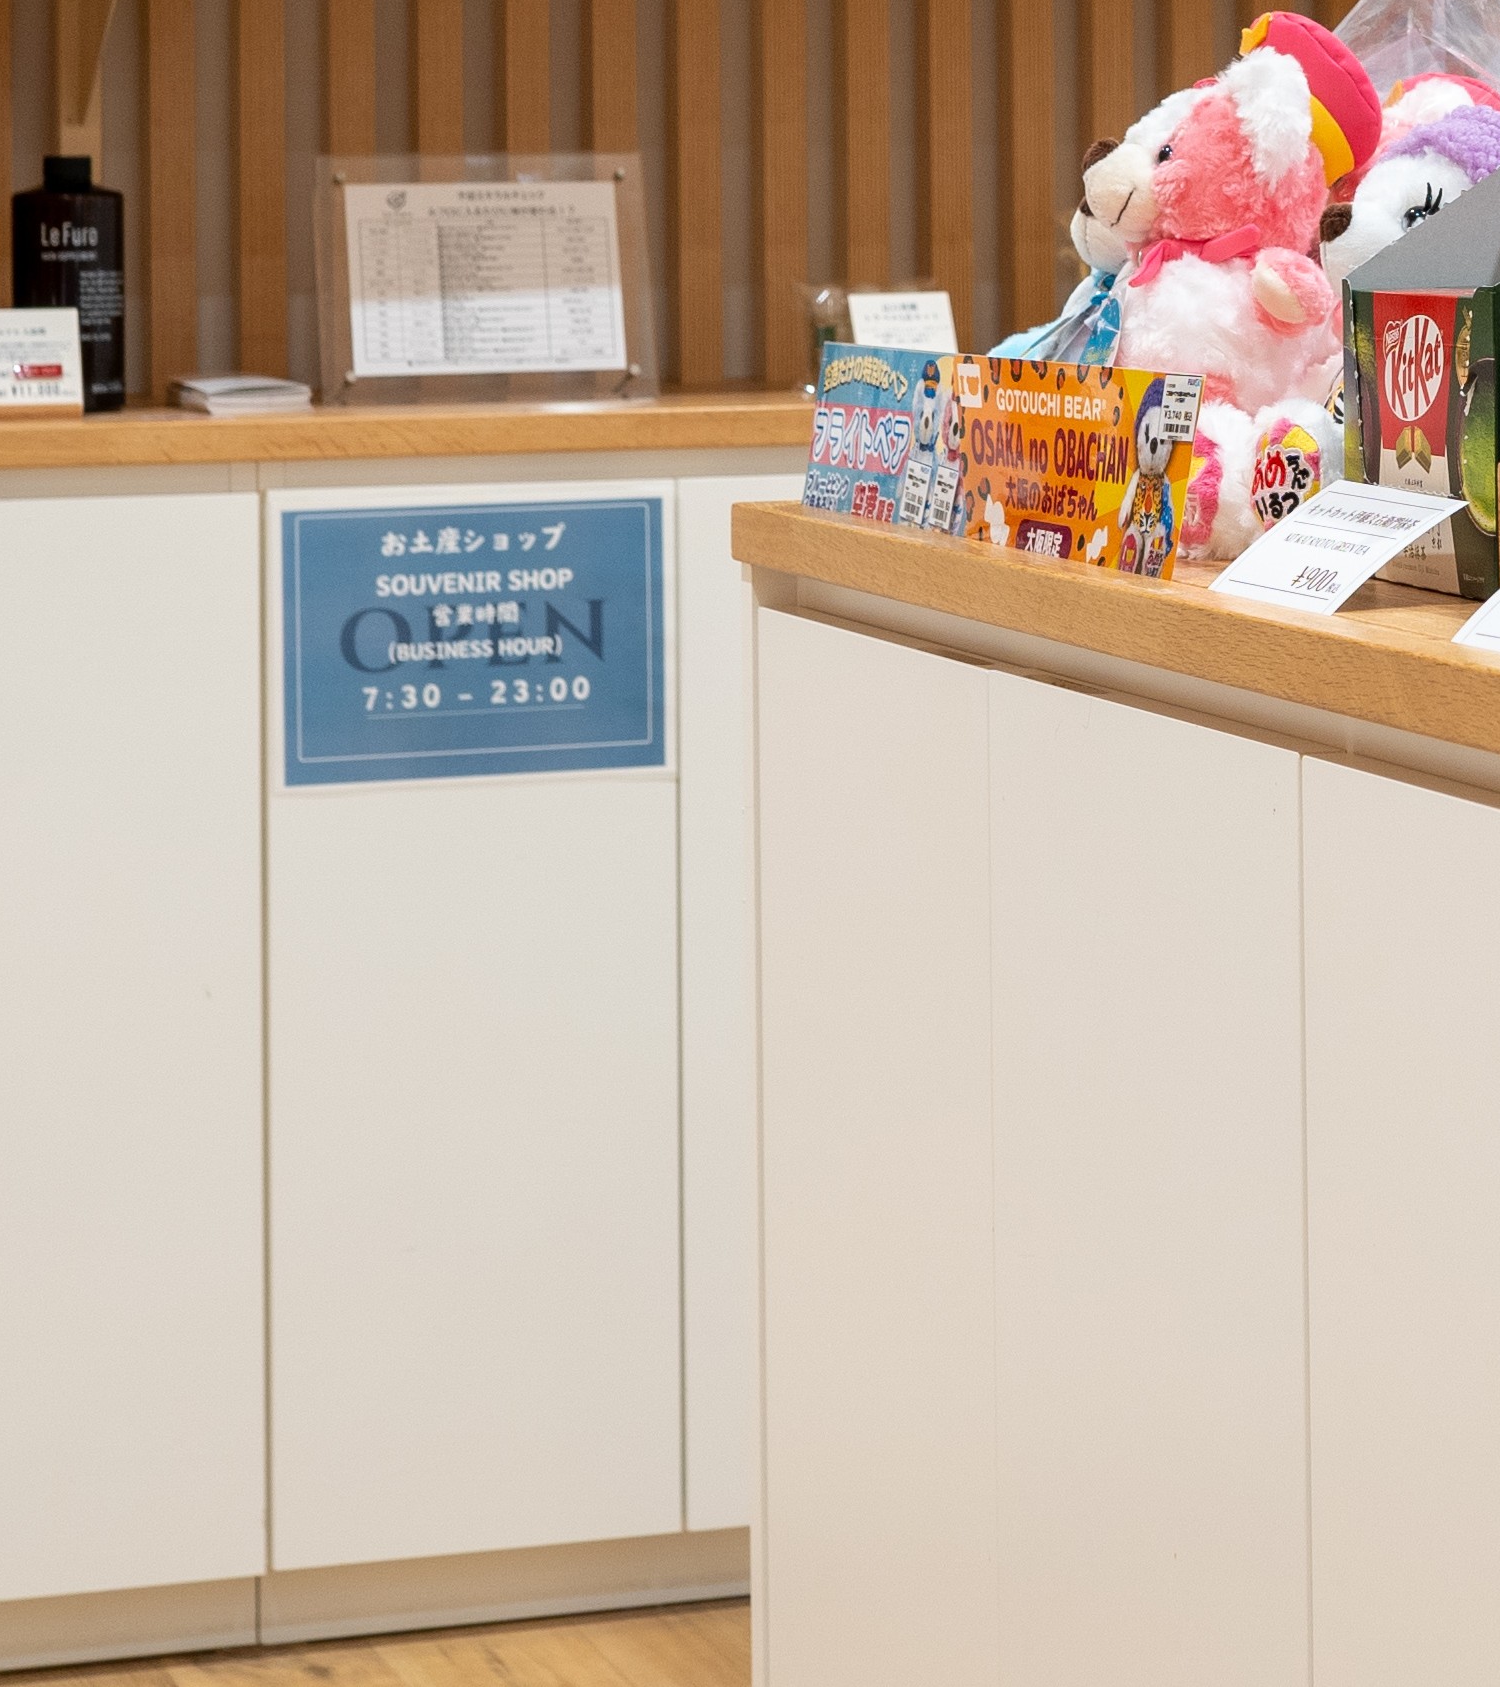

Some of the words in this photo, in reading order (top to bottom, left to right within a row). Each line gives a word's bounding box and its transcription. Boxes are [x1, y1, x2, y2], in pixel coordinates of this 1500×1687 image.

[1391, 317, 1441, 419] KitKat
[996, 388, 1061, 418] GOTOUCHI
[813, 408, 911, 474] フライトベア
[971, 418, 1024, 470] OSAKA
[1029, 436, 1048, 474] no
[1053, 427, 1130, 485] OBACHAN
[1005, 476, 1097, 521] 大阪のおばちゃん
[380, 522, 565, 556] お土産ショップ
[1024, 527, 1063, 559] 大阪限定
[375, 569, 501, 597] SOUVENIR
[508, 567, 574, 593] SHOP
[1292, 566, 1338, 592] ¥900
[339, 598, 607, 675] OPEN
[388, 637, 494, 663] (BUSINESS
[498, 634, 562, 658] HOUR)
[362, 683, 442, 711] 7:30
[490, 677, 591, 705] 23:00
